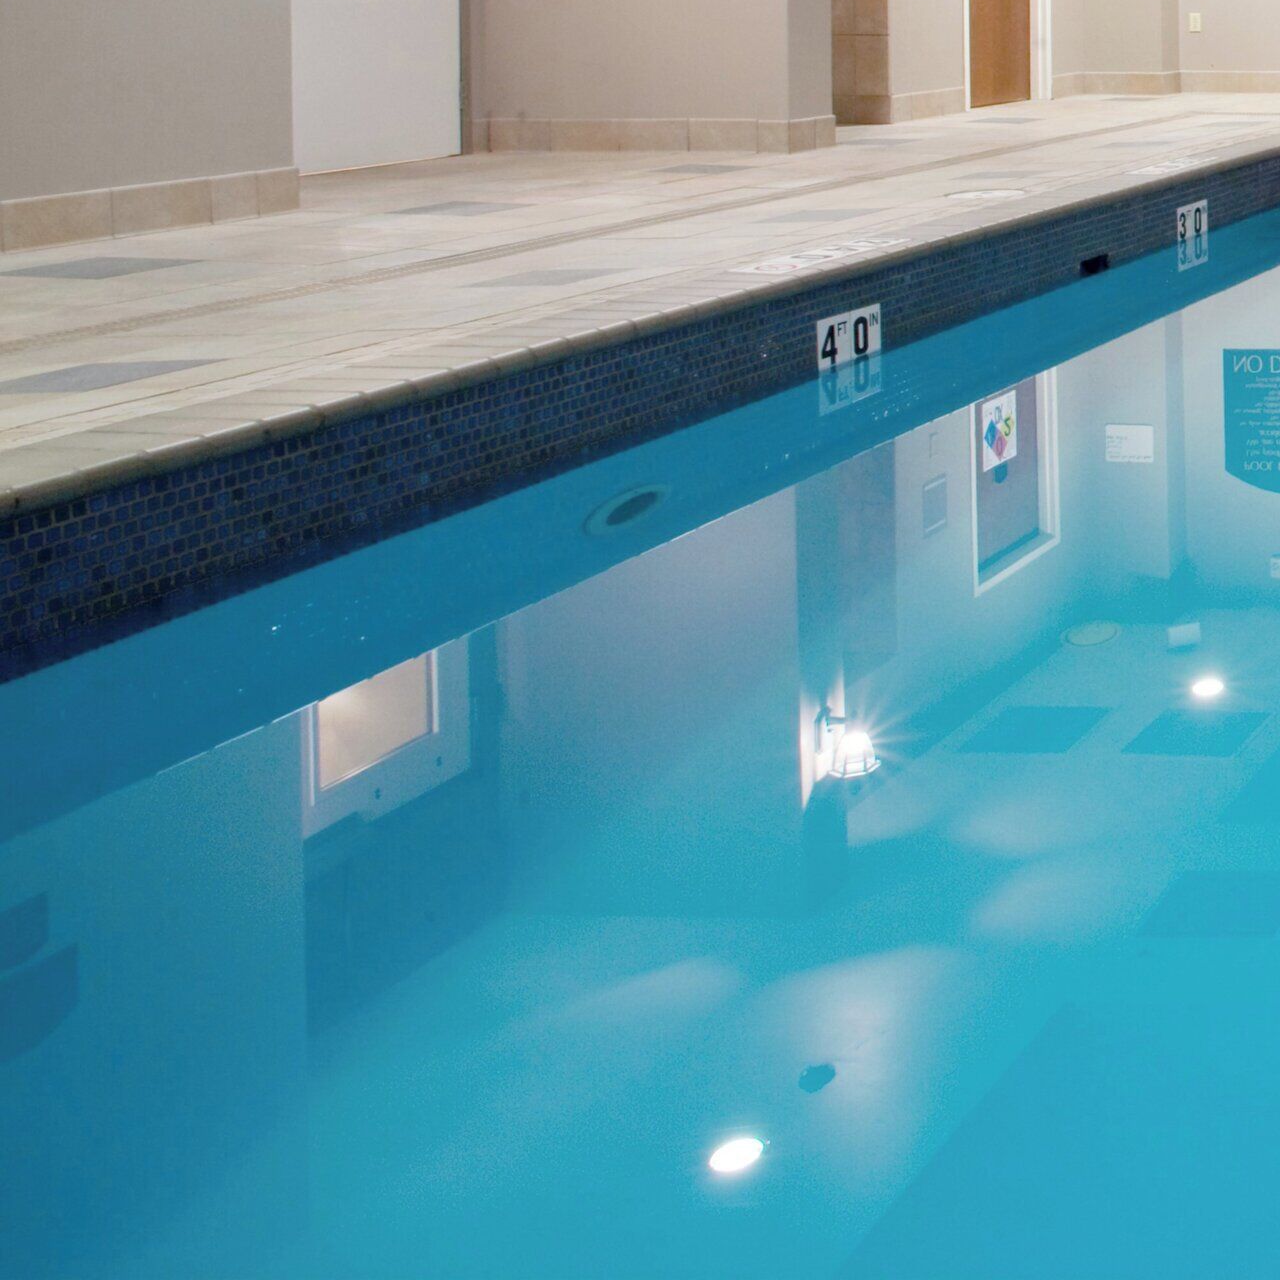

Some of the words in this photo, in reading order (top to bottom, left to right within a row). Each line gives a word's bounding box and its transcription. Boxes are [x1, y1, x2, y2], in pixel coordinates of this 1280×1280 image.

[1179, 212, 1187, 239] 3
[1194, 207, 1202, 233] 0
[821, 324, 838, 365] 4
[837, 321, 848, 336] FT
[853, 316, 869, 356] 0
[869, 312, 879, 327] IN
